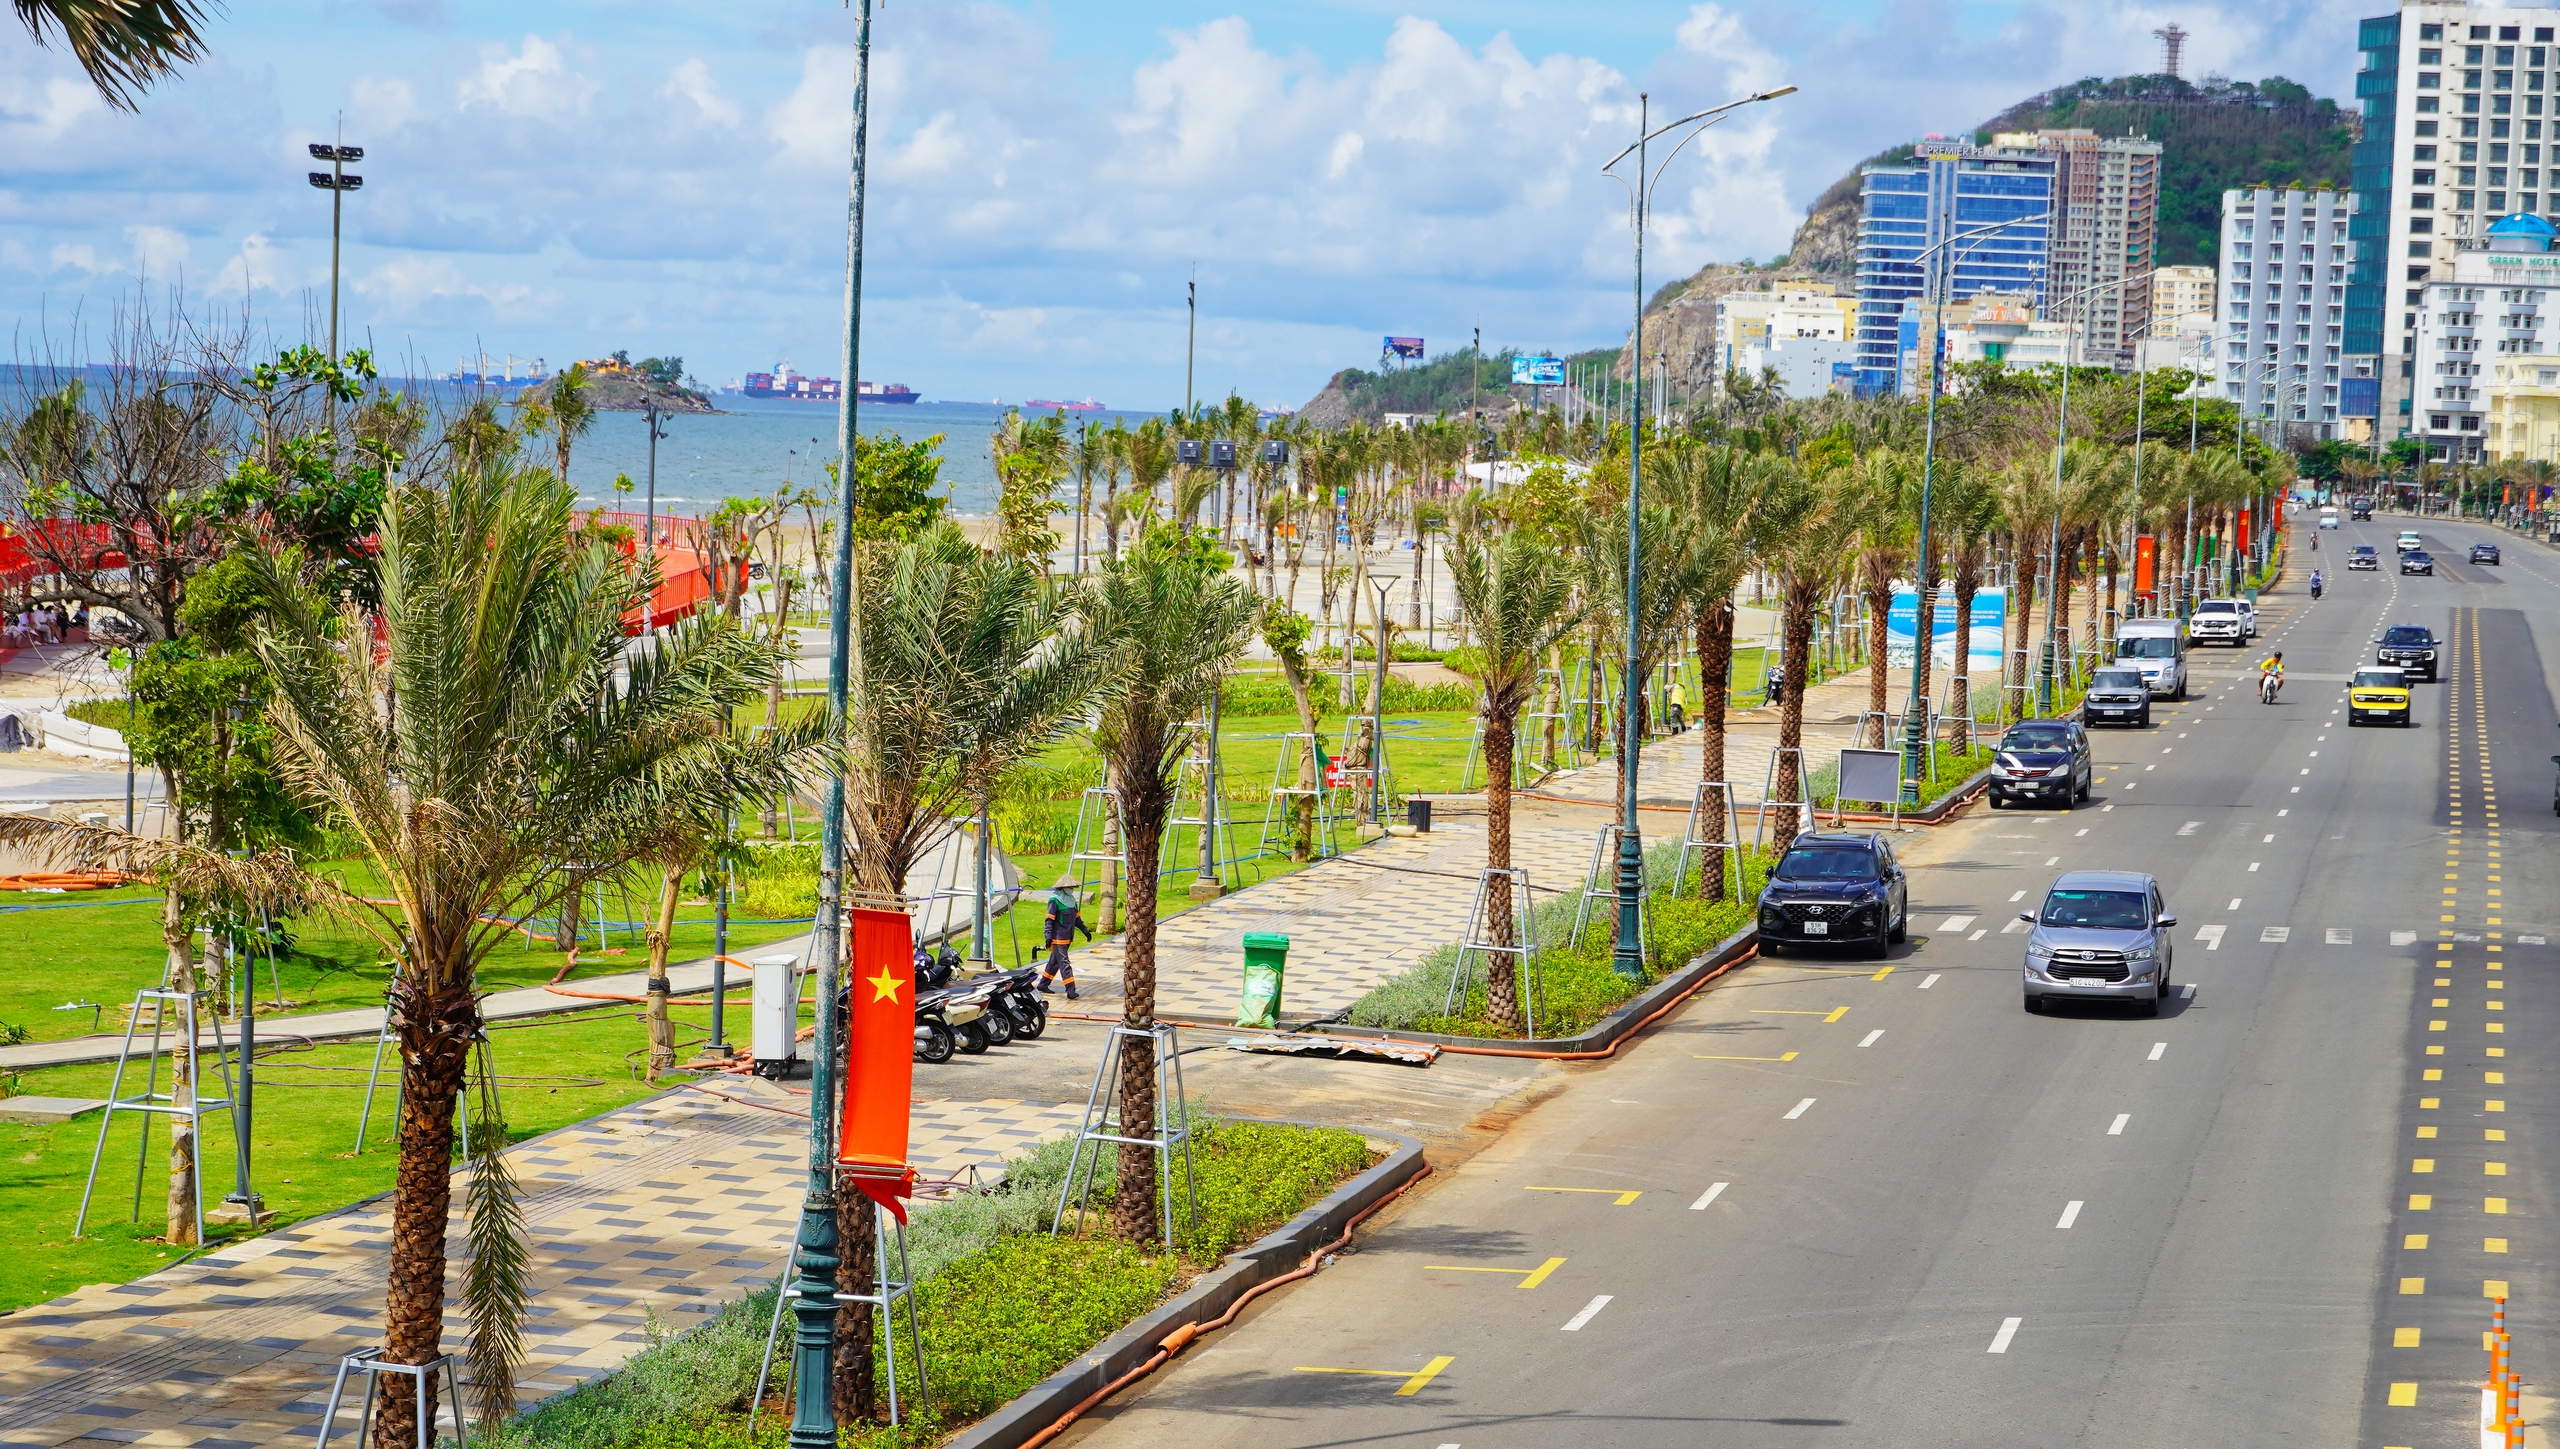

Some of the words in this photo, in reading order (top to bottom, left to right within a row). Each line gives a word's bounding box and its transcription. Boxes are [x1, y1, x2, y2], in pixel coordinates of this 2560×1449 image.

[1927, 146, 1969, 157] PREMIER
[2487, 256, 2523, 265] GREEN
[2529, 257, 2560, 267] HOTE
